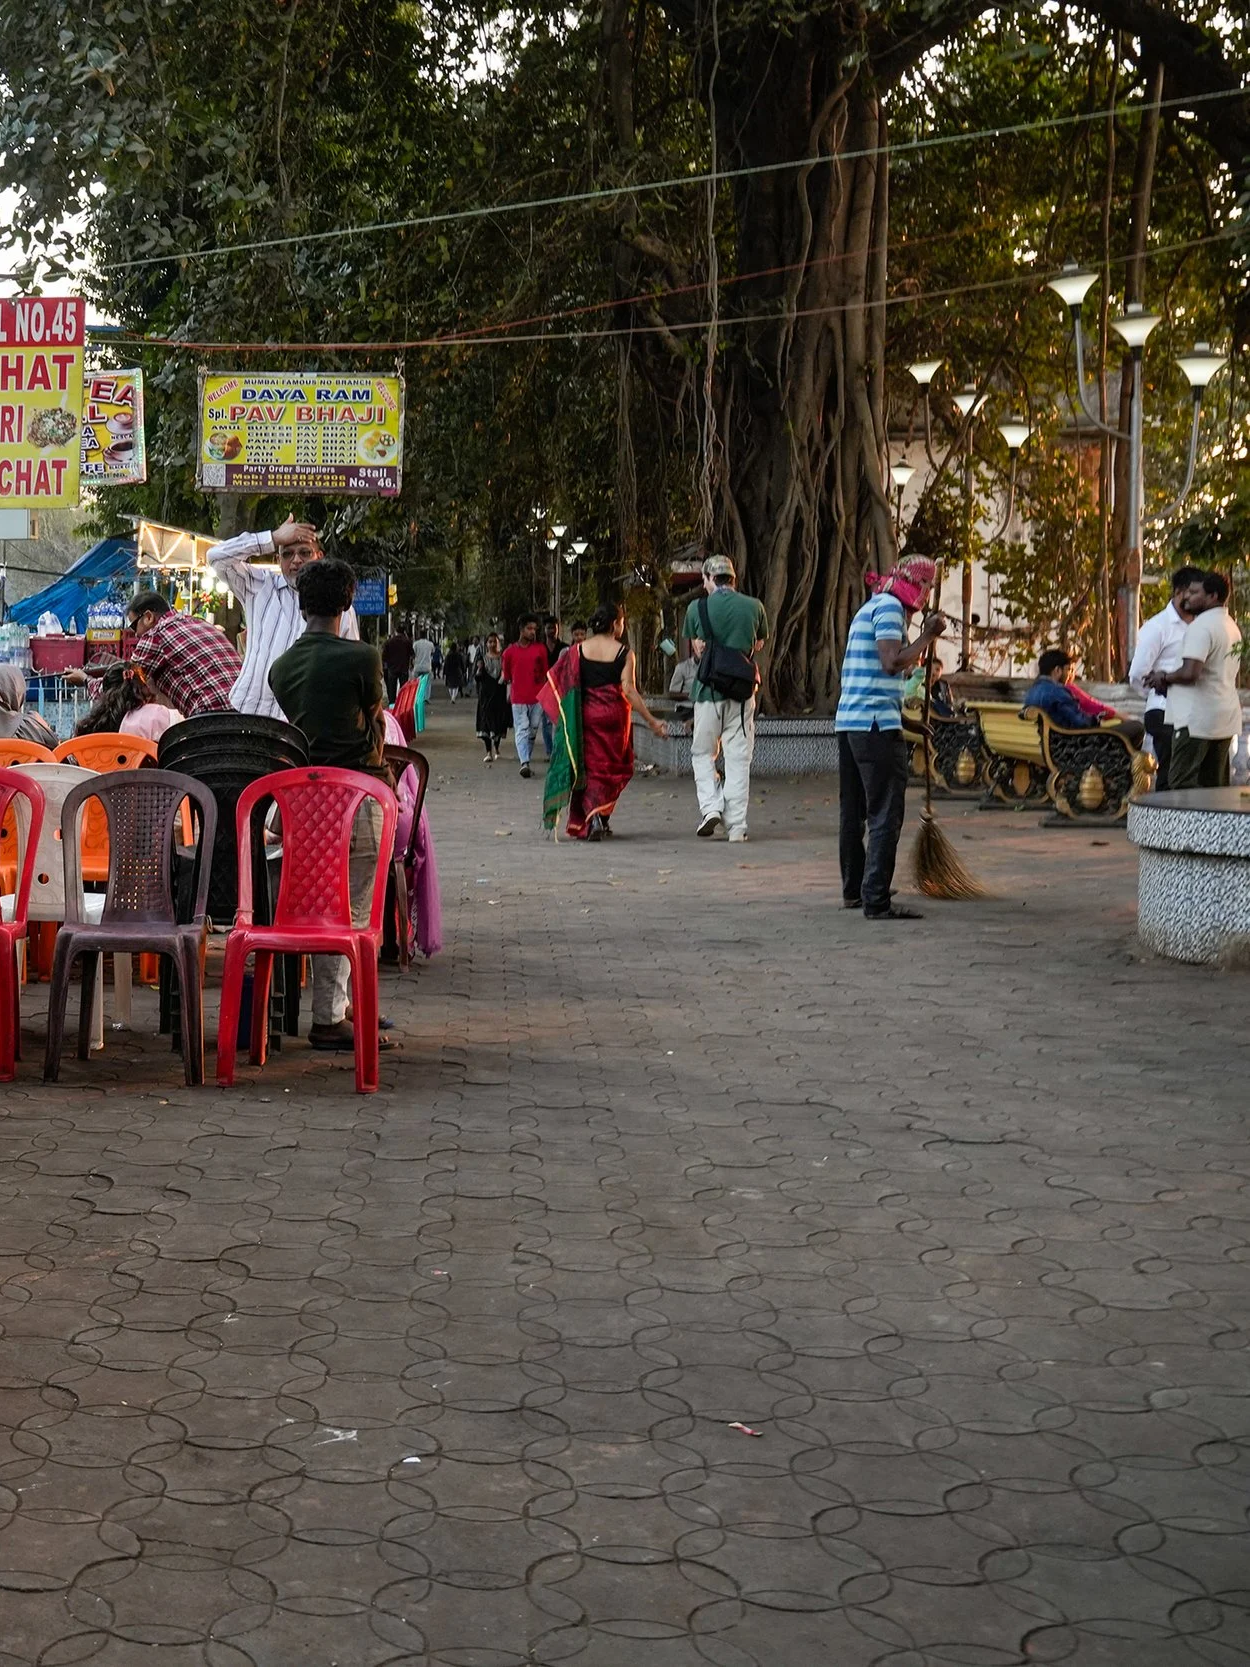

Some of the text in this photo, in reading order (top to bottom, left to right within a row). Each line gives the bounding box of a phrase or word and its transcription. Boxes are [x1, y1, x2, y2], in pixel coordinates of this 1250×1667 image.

[15, 302, 76, 342] NO.45
[85, 379, 134, 407] EA
[207, 379, 239, 402] WELCOME
[241, 389, 372, 401] DAYA RAM
[375, 379, 397, 411] WELCOME
[208, 405, 386, 423] Spl. PAV BHAJI
[244, 465, 266, 474] Party
[295, 465, 335, 474] Suppliers
[358, 468, 387, 477] Stall
[350, 478, 369, 487] No.
